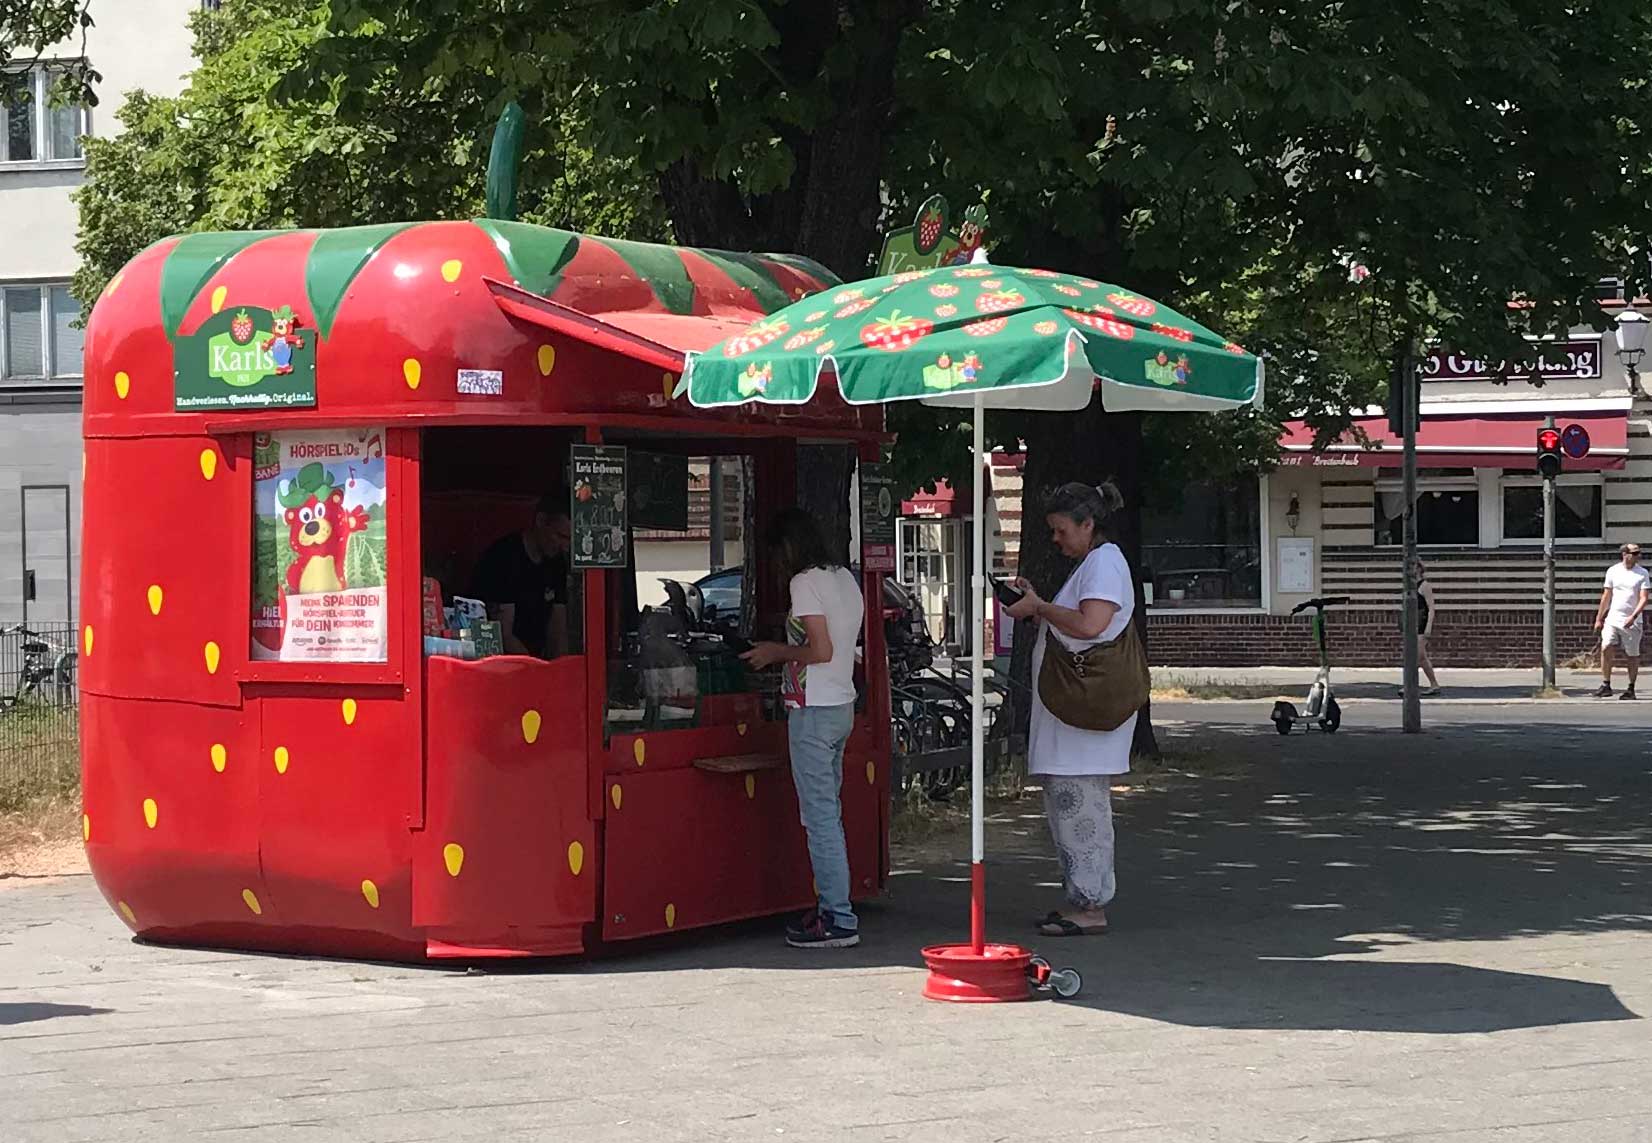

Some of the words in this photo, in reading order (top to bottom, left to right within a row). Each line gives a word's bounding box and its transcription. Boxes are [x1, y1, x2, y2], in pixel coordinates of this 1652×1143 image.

[213, 341, 274, 373] Karls
[272, 391, 314, 404] Original.
[306, 620, 331, 632] DEIN
